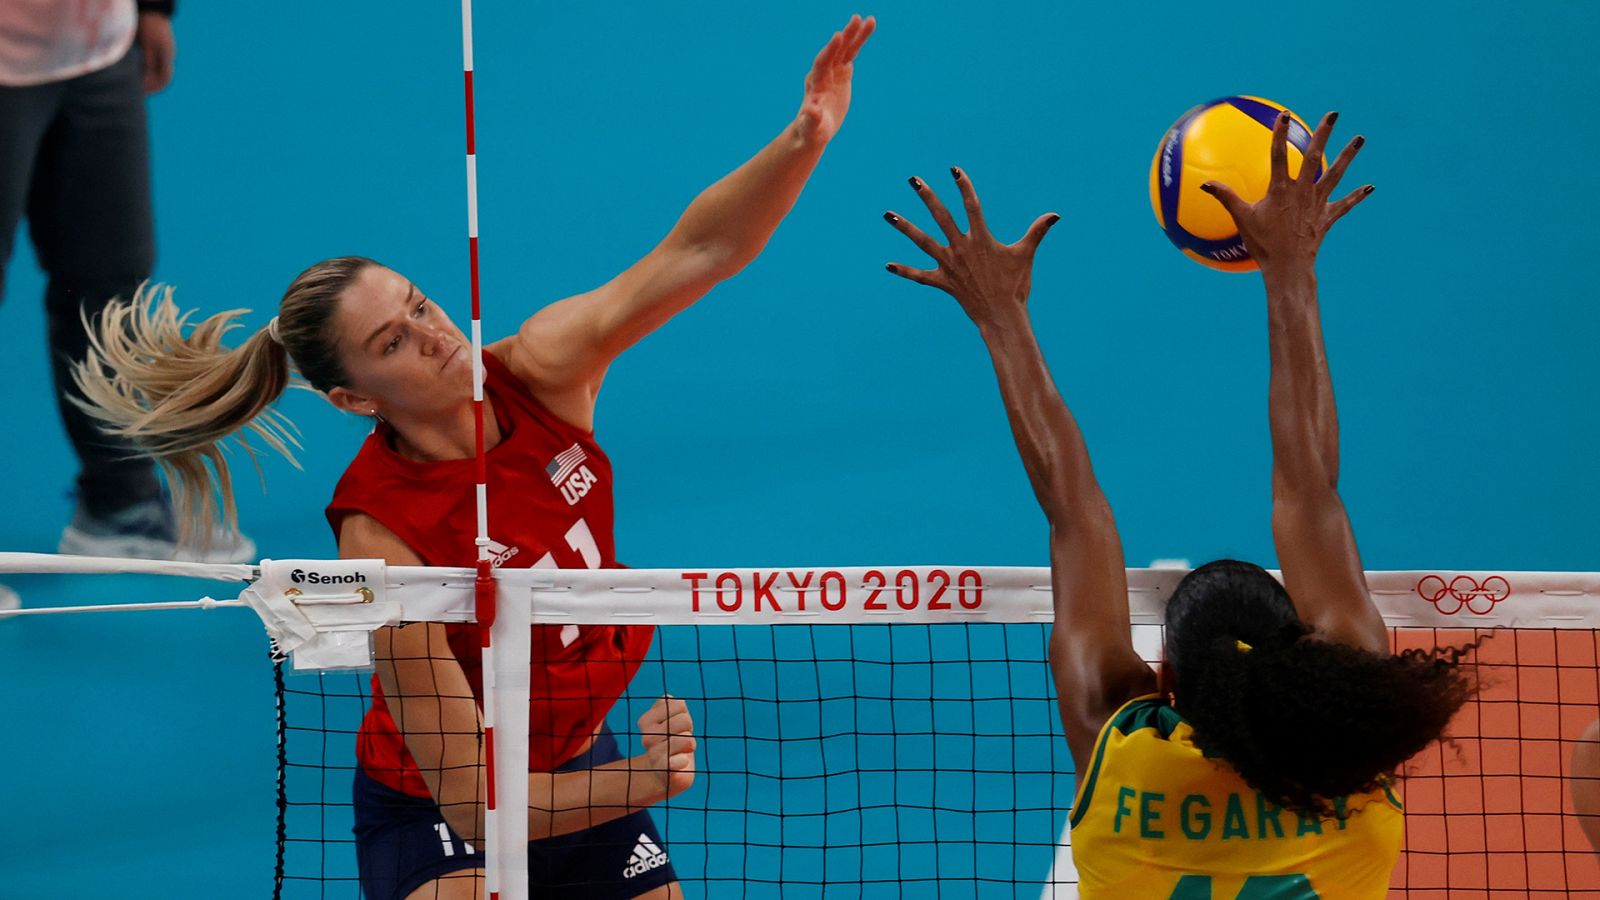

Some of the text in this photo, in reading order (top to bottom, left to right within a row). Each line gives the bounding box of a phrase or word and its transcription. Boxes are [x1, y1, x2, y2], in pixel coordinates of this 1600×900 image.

[1209, 242, 1248, 260] TOKY
[560, 465, 598, 506] USA
[307, 571, 367, 585] Senoh
[681, 569, 983, 612] TOKYO 2020
